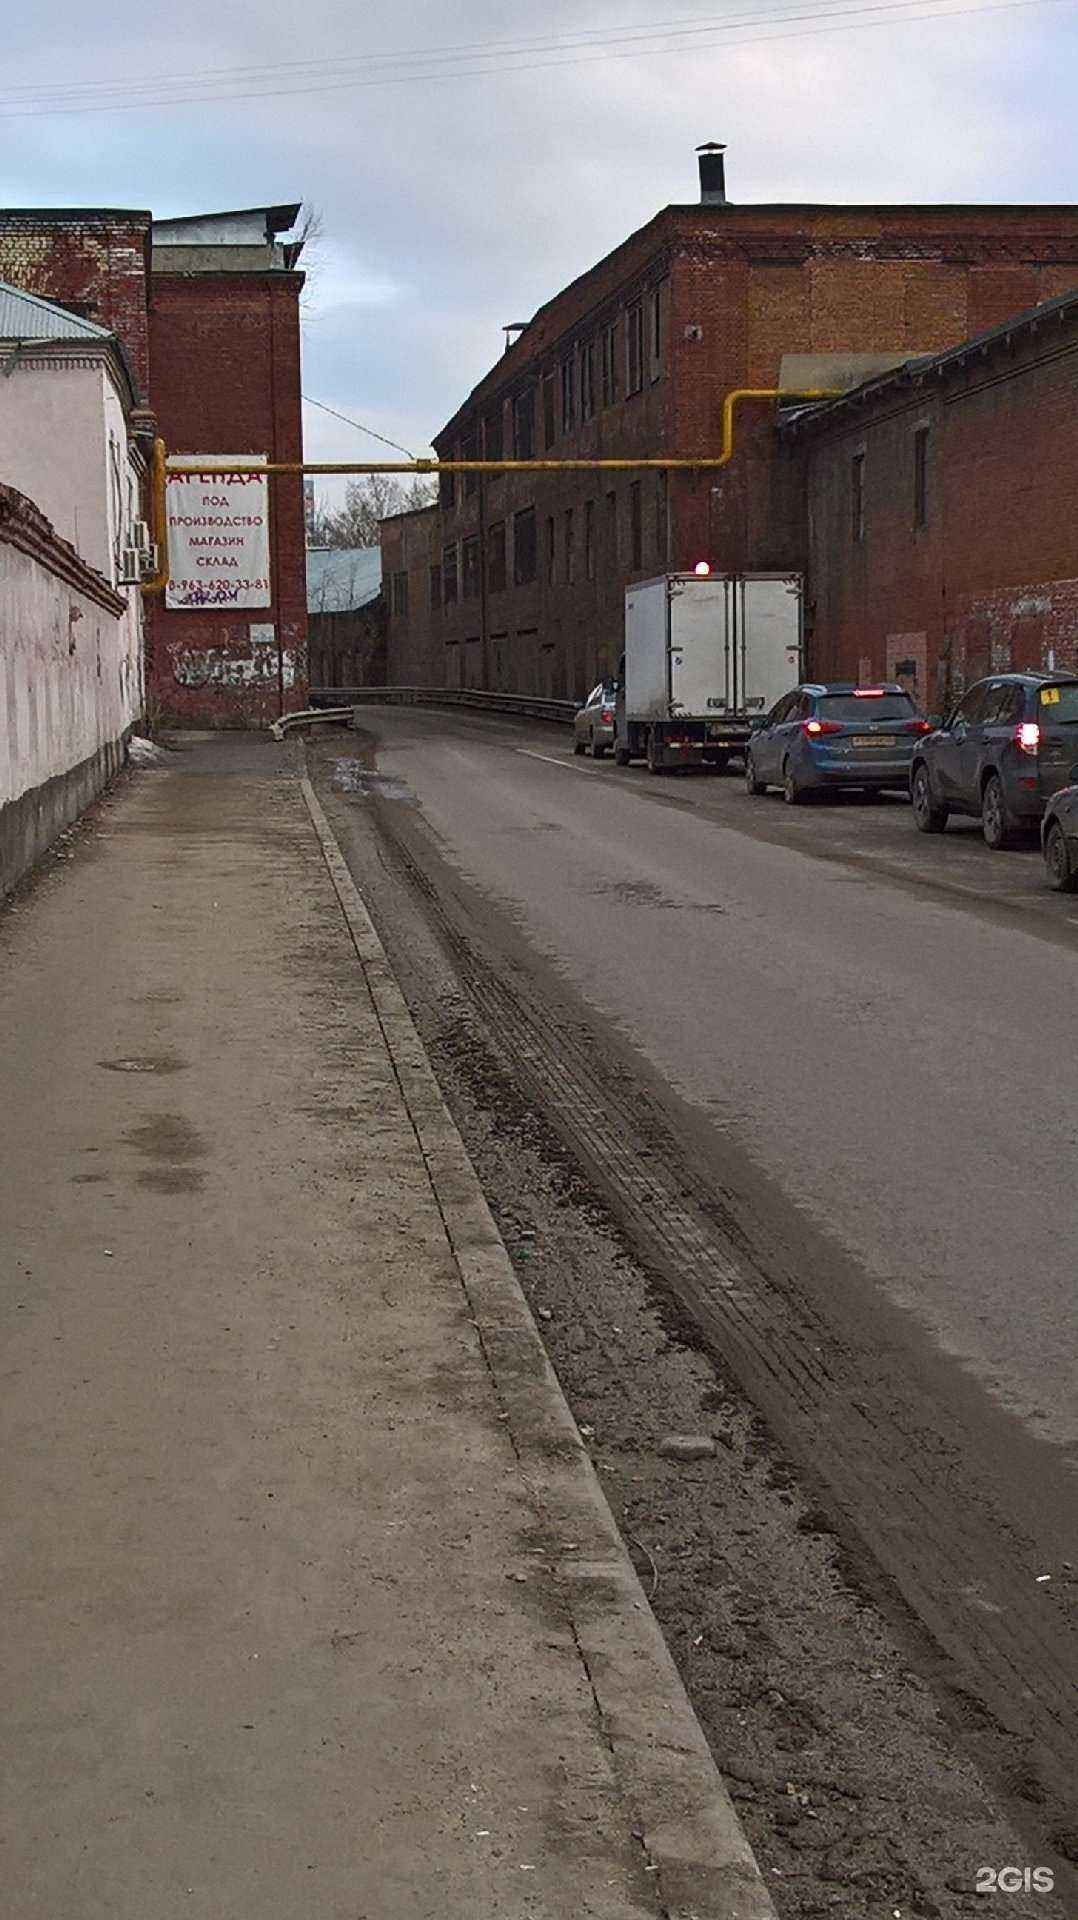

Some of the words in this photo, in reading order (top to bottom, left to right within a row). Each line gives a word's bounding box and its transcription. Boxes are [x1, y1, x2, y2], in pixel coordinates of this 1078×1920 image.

[202, 496, 230, 507] ПОД
[169, 516, 264, 527] ПРОИЗВОДСТВО
[188, 536, 244, 546] МАГАЗИН
[196, 556, 239, 567] СКЛАД
